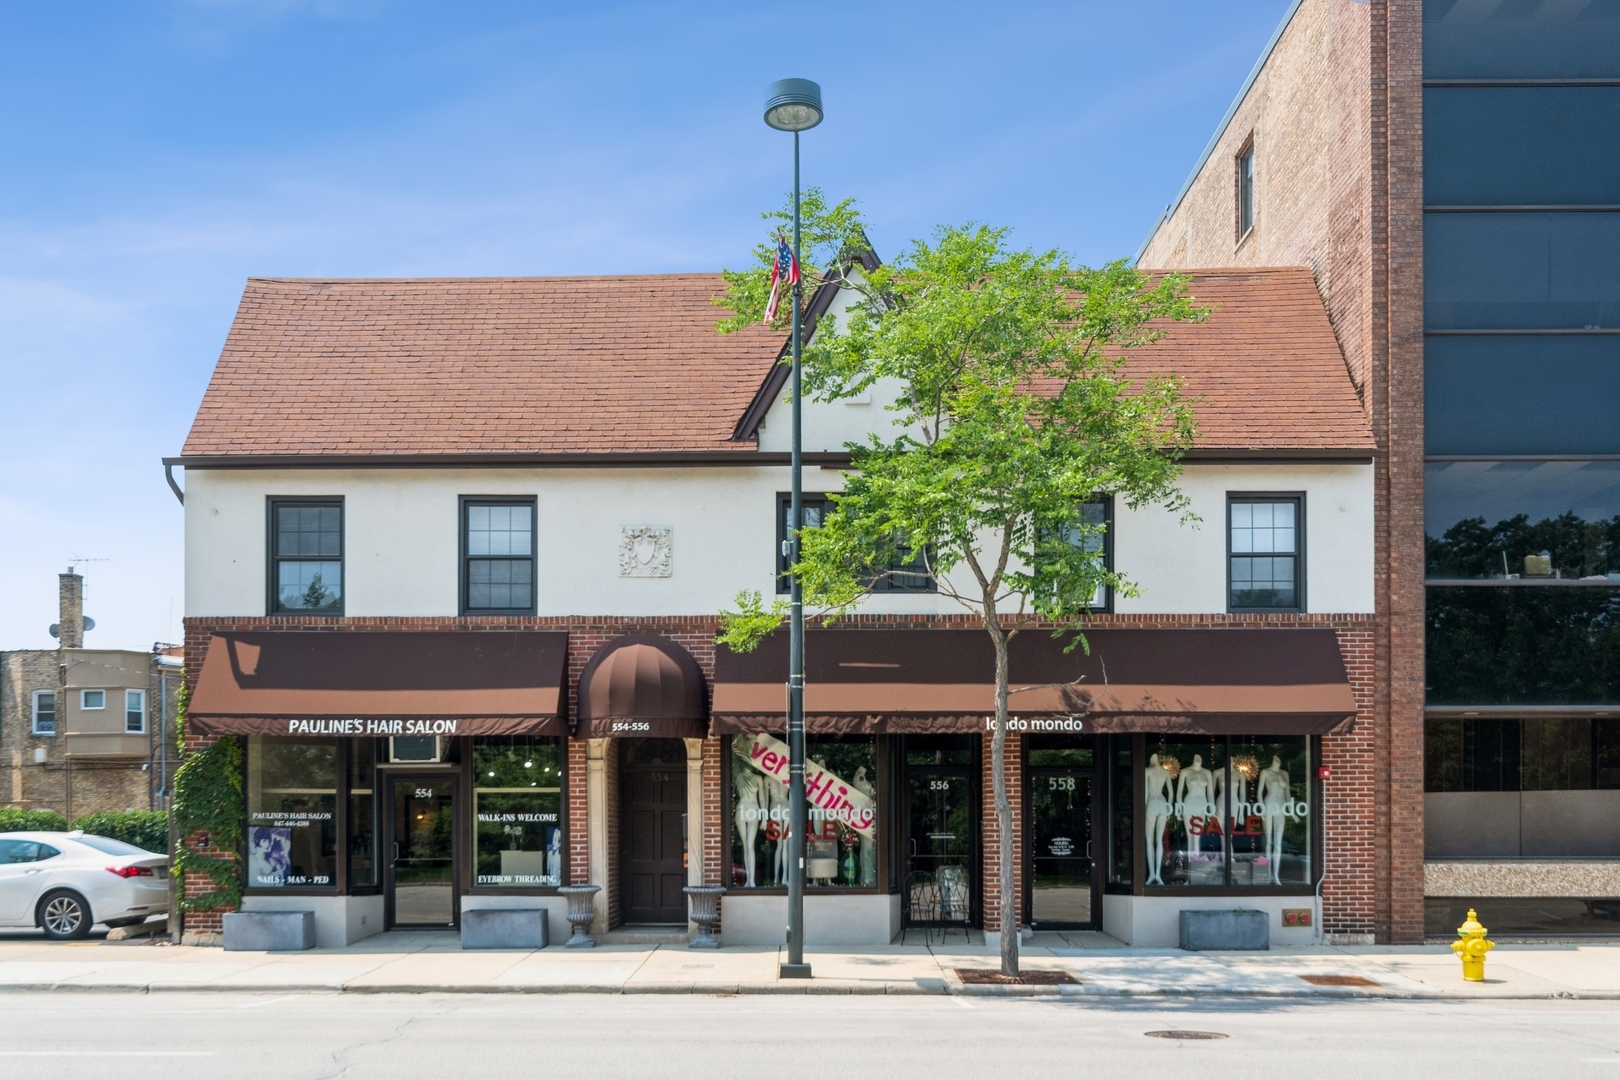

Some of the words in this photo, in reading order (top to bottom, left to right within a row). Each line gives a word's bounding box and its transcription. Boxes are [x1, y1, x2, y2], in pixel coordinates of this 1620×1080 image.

[288, 718, 363, 734] PAULINE'S
[366, 719, 403, 734] HAIR
[405, 719, 457, 734] SALON
[612, 722, 650, 731] 554-556
[986, 716, 1028, 731] lodo
[1031, 716, 1083, 731] mondo
[930, 780, 949, 790] 556
[1049, 777, 1076, 790] 558
[414, 788, 432, 798] 554
[808, 804, 873, 820] mondo
[1232, 796, 1309, 817] mondo
[477, 813, 516, 822] WALK-INS
[517, 813, 558, 822] WELCOME
[1189, 816, 1262, 836] SALE
[256, 875, 280, 884] NAILS
[287, 875, 307, 884] MAN
[313, 875, 329, 884] PED
[477, 875, 513, 883] EYEBROW
[514, 875, 557, 883] THREADING
